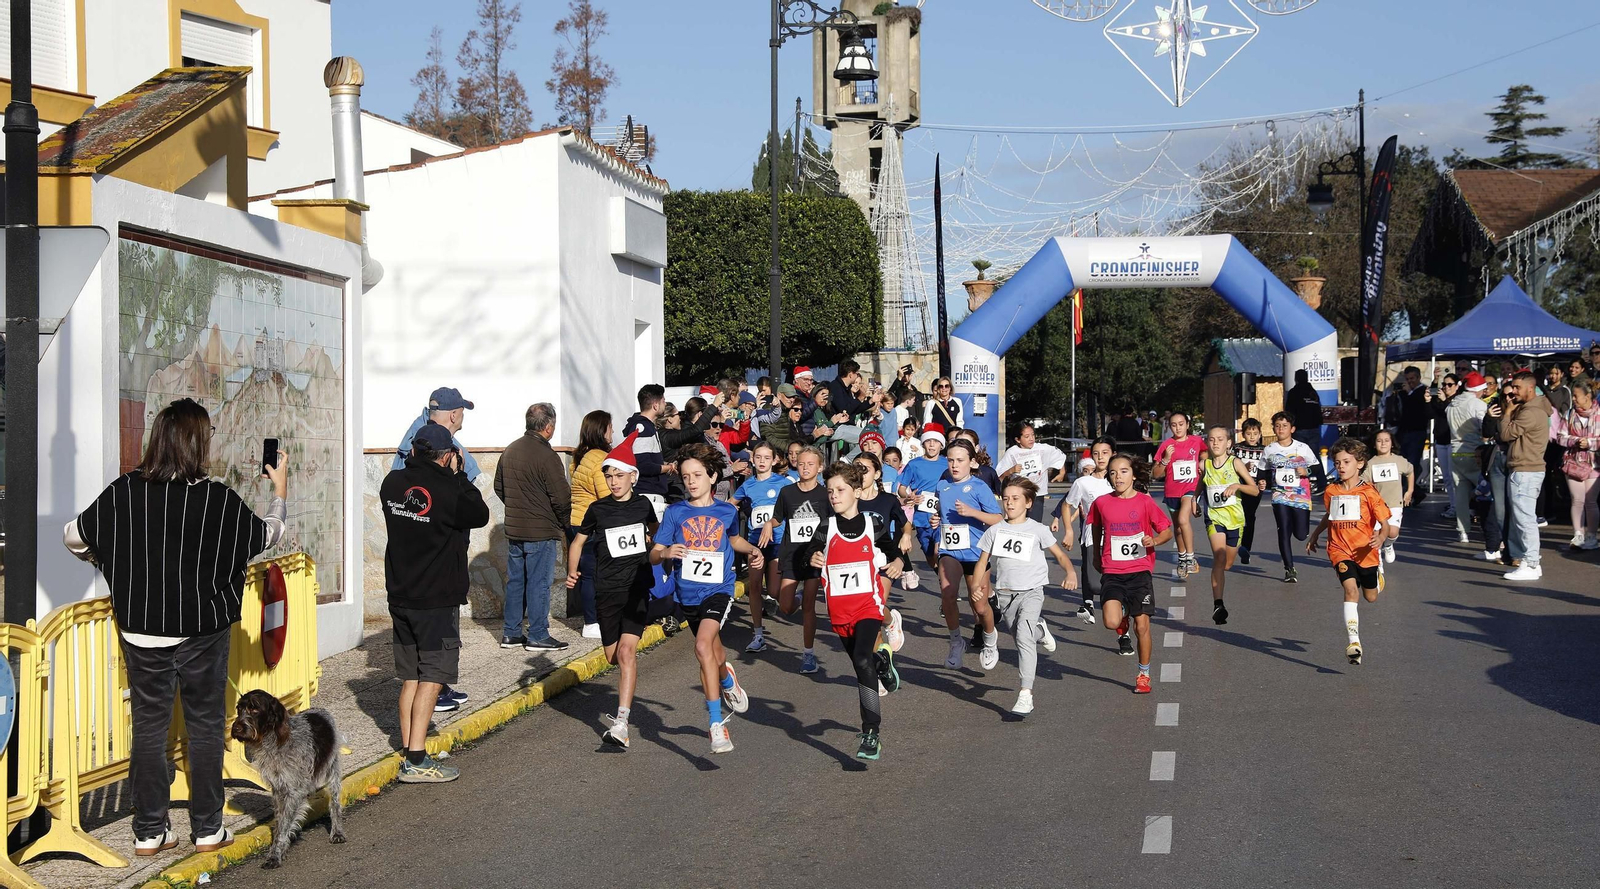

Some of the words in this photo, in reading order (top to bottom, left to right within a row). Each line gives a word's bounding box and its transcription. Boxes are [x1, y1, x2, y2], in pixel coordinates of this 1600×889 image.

[1368, 221, 1387, 298] Running
[1090, 261, 1199, 277] CRONOFINISHER
[963, 364, 989, 373] CRONO
[1303, 361, 1329, 371] CRONO
[955, 372, 995, 385] FINISHER
[1309, 369, 1335, 382] ISHER
[1024, 460, 1037, 470] 52
[1180, 466, 1191, 476] 56
[1281, 474, 1294, 483] 48
[1380, 469, 1391, 477] 41
[391, 507, 418, 521] Running
[1340, 503, 1345, 515] 1
[756, 512, 770, 524] 50
[797, 525, 813, 538] 49
[1339, 521, 1358, 530] BETTER
[618, 533, 638, 550] 64
[945, 532, 960, 545] 59
[1002, 538, 1023, 554] 46
[1120, 542, 1139, 556] 62
[692, 560, 713, 577] 72
[839, 571, 860, 589] 71
